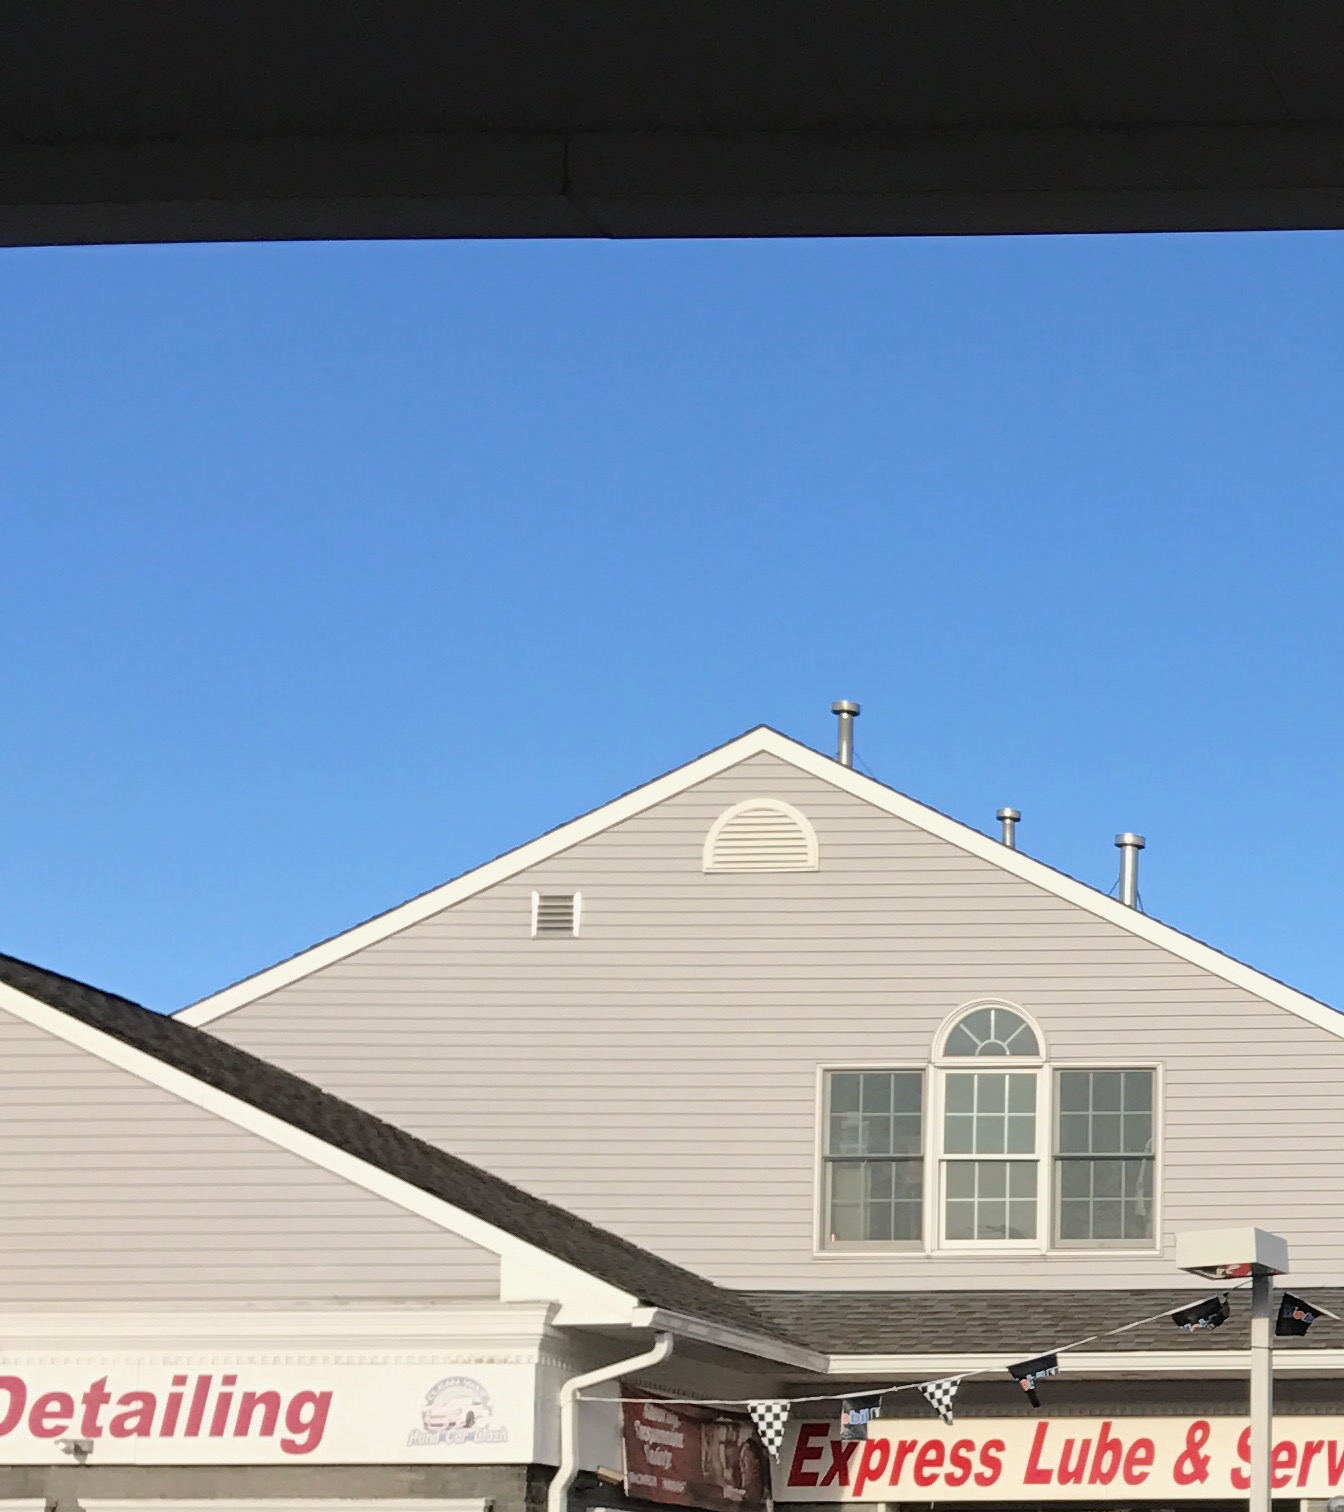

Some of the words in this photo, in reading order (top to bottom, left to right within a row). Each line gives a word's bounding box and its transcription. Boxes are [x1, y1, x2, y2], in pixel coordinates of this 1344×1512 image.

[407, 1428, 441, 1447] Hand
[445, 1430, 469, 1445] Car
[474, 1425, 508, 1444] Wash
[787, 1423, 1006, 1497] Express
[1023, 1421, 1155, 1486] Lube
[1173, 1420, 1211, 1485] &
